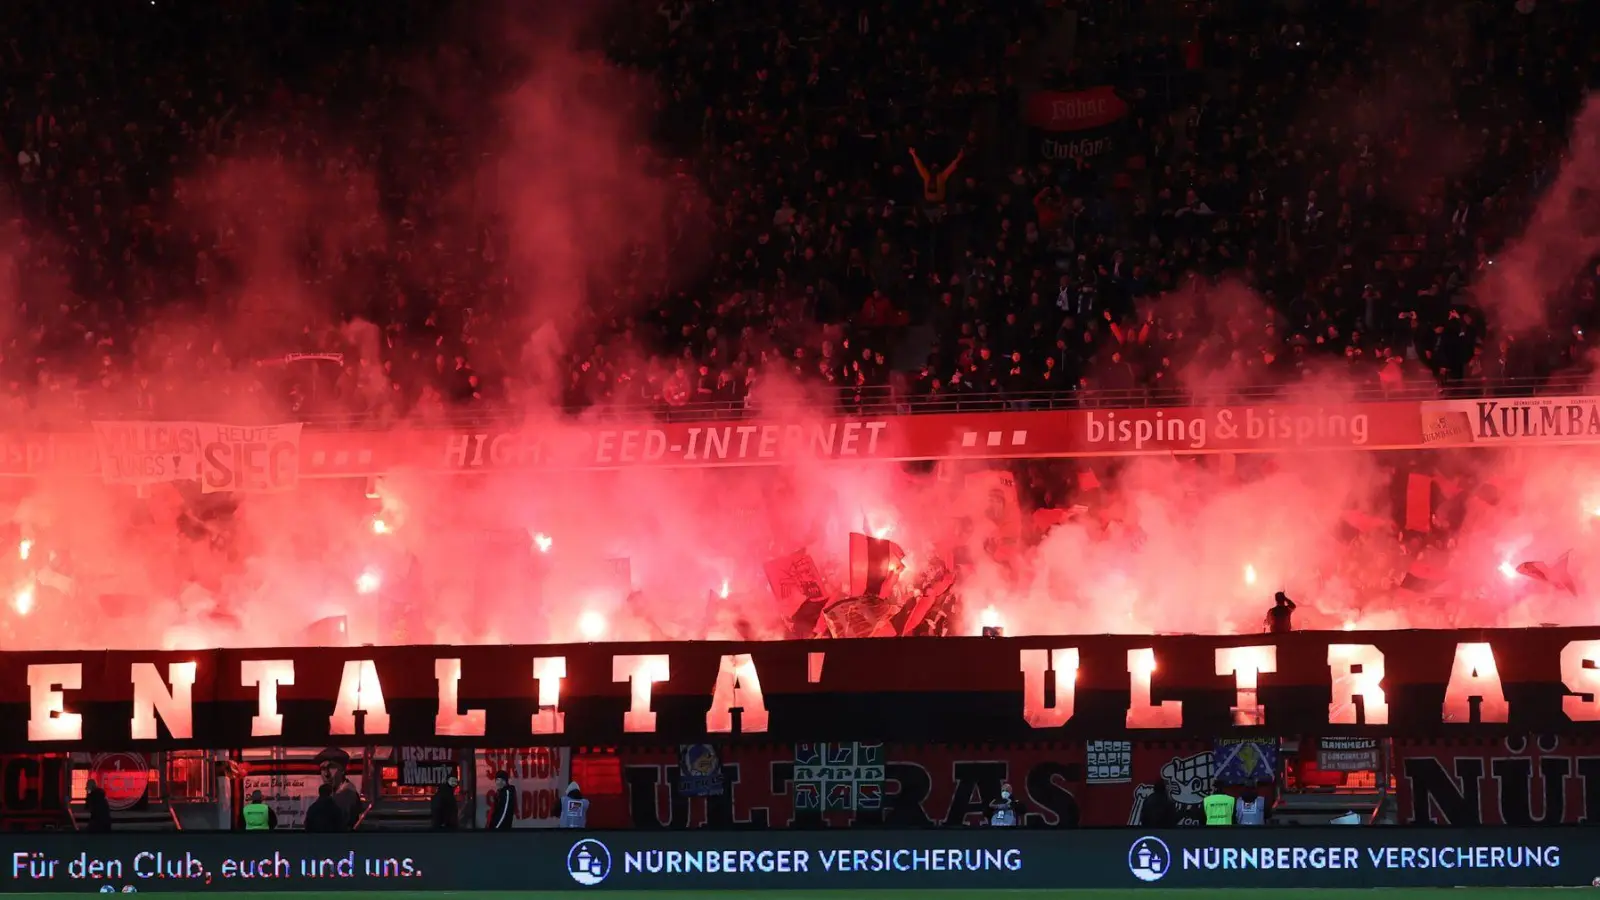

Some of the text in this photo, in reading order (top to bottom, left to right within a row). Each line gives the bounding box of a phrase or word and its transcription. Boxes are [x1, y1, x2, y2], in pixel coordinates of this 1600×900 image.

[217, 427, 279, 442] HEUTE
[547, 421, 887, 464] EED-INTERNET
[1087, 408, 1368, 448] bisping & bisping
[204, 441, 297, 488] SIEG
[1020, 640, 1600, 728] ULTRAS
[485, 747, 560, 780] SEKTION
[1087, 766, 1130, 778] 2004
[1404, 736, 1600, 825] NÜ
[485, 789, 560, 823] SADION
[13, 851, 422, 884] Für den Club, euch und uns.
[624, 848, 1022, 874] NÜRNBERGER VERSICHERUNG
[1182, 845, 1560, 869] NÜRNBERGER VERSICHERUNG
